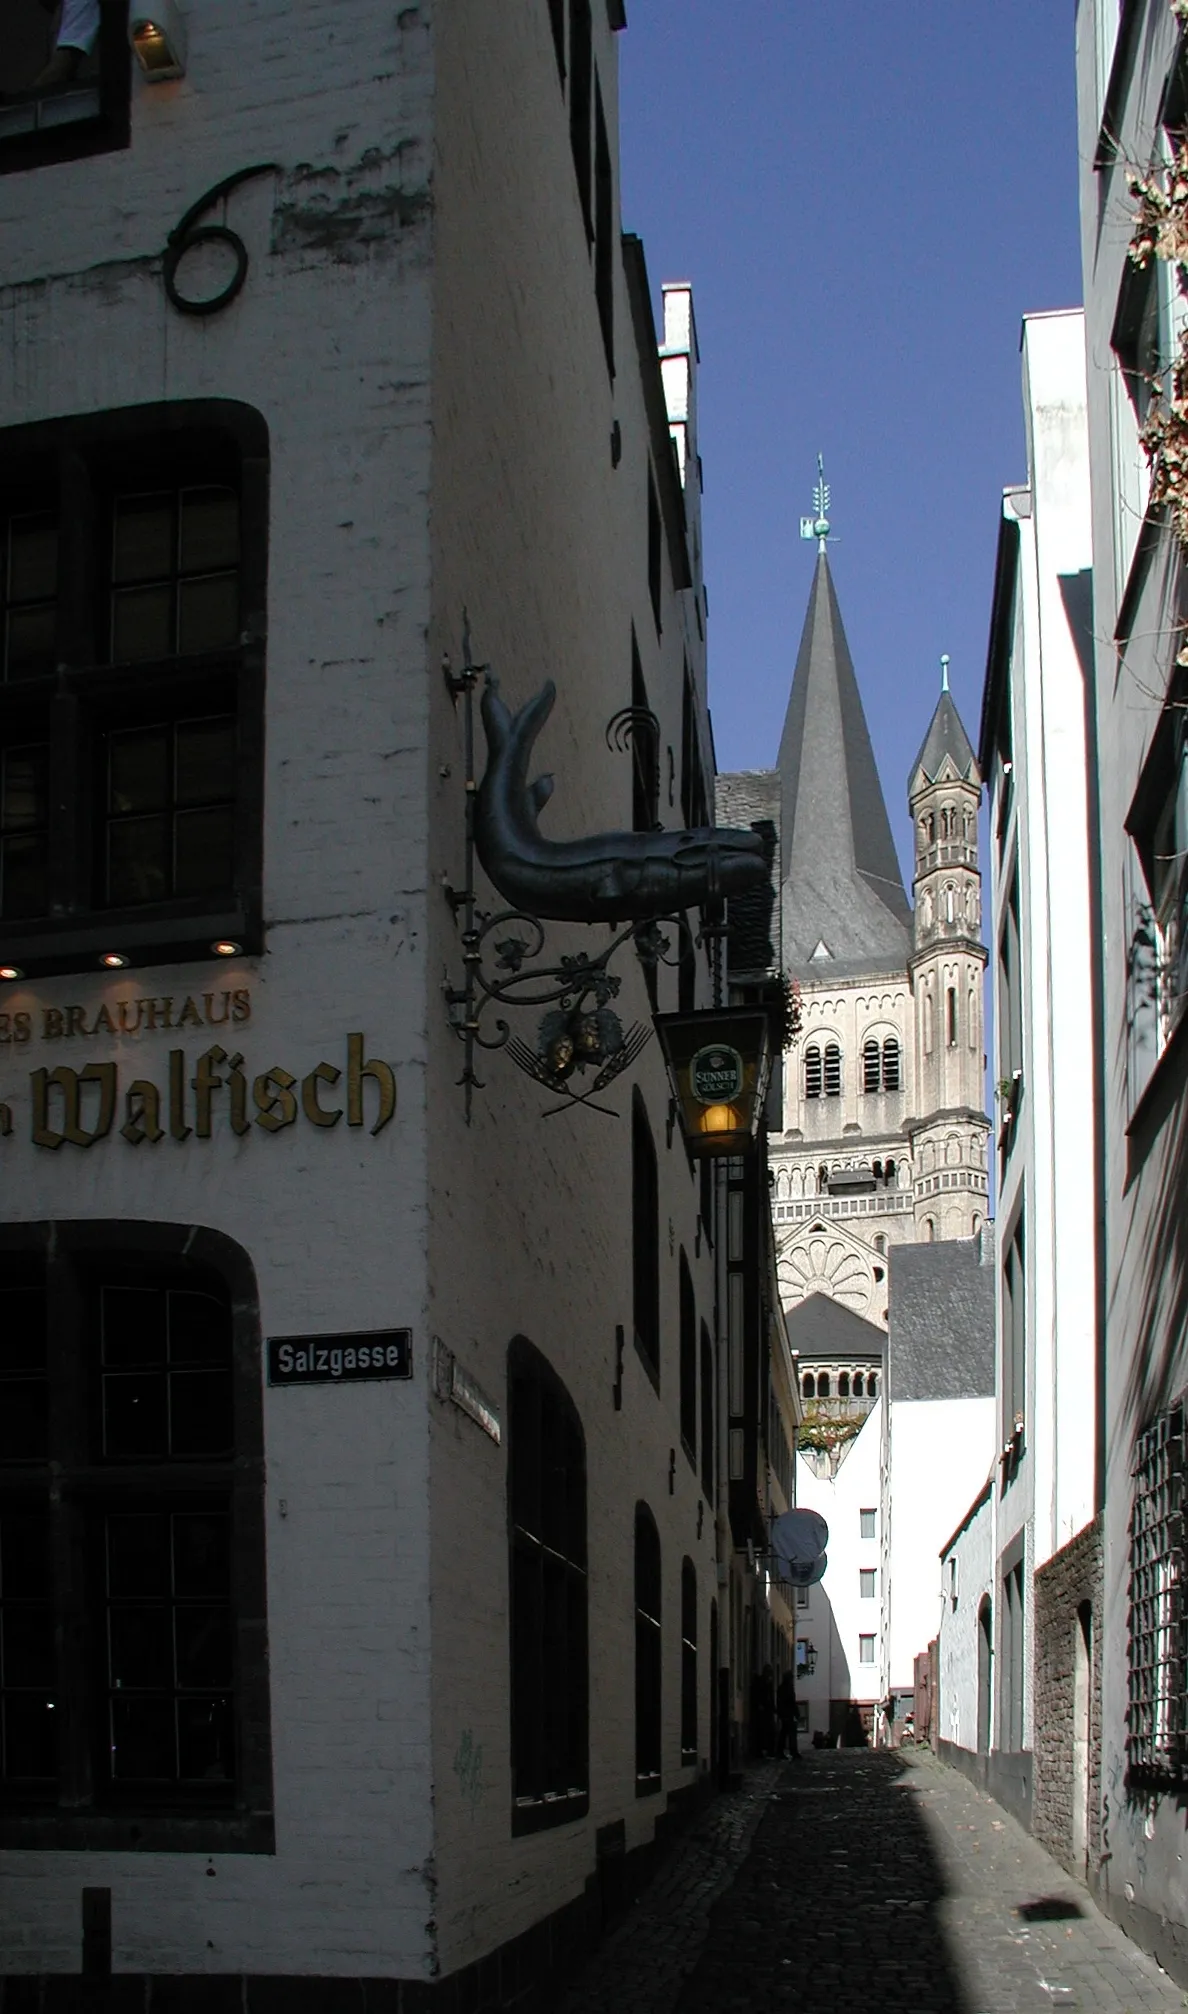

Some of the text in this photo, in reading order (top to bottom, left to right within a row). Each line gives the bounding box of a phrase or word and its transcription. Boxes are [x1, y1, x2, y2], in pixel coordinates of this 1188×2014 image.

[41, 988, 252, 1040] BRAUHAUS
[30, 1032, 397, 1150] Walfisch
[278, 1342, 400, 1376] Salzgasse
